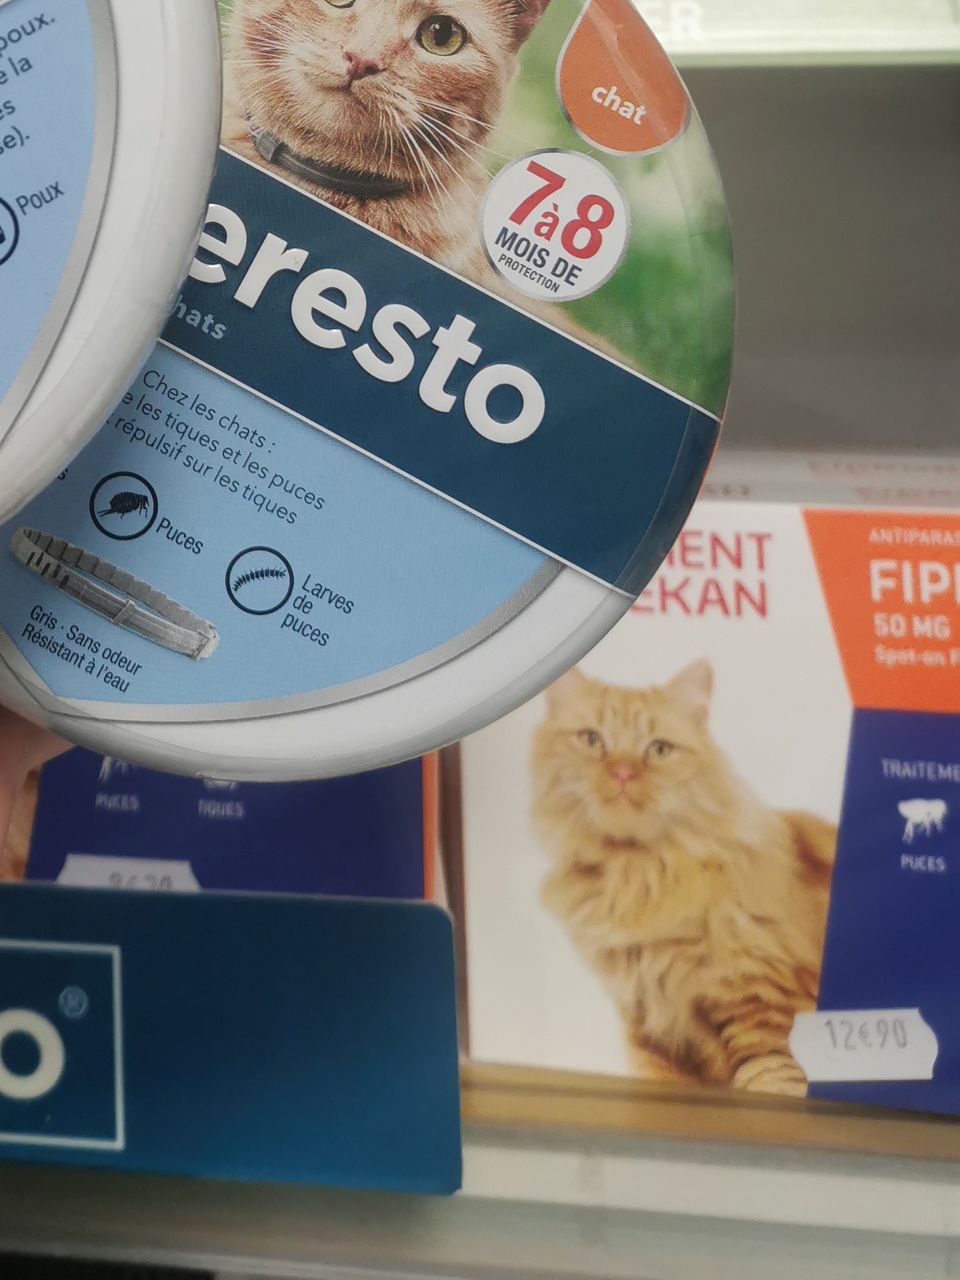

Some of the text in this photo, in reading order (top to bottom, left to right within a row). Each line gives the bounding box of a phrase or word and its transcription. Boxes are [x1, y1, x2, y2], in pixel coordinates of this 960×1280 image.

[11, 52, 34, 77] la
[590, 83, 650, 127] chat
[14, 180, 66, 217] Poux
[493, 225, 584, 289] MOIS DE
[496, 252, 561, 294] PROTECTION
[171, 293, 228, 340] hats
[189, 202, 546, 445] eresto
[142, 369, 268, 450] Chez les chats
[114, 416, 299, 525] répulsif sur les tiques
[136, 393, 161, 422] les
[165, 411, 220, 453] tiques
[221, 444, 243, 466] et
[242, 453, 270, 480] les
[268, 471, 327, 511] puces
[155, 516, 205, 556] Puces
[302, 573, 356, 616] Larves
[869, 559, 960, 604] FIP
[292, 593, 314, 616] de
[29, 604, 144, 678] Gris Sans odeur
[280, 610, 331, 648] puces
[873, 613, 952, 641] 50 MG
[21, 623, 131, 695] Résistant à l'eau
[874, 644, 946, 667] Spot-on
[899, 853, 946, 873] PUCES
[824, 1016, 909, 1051] 12€90
